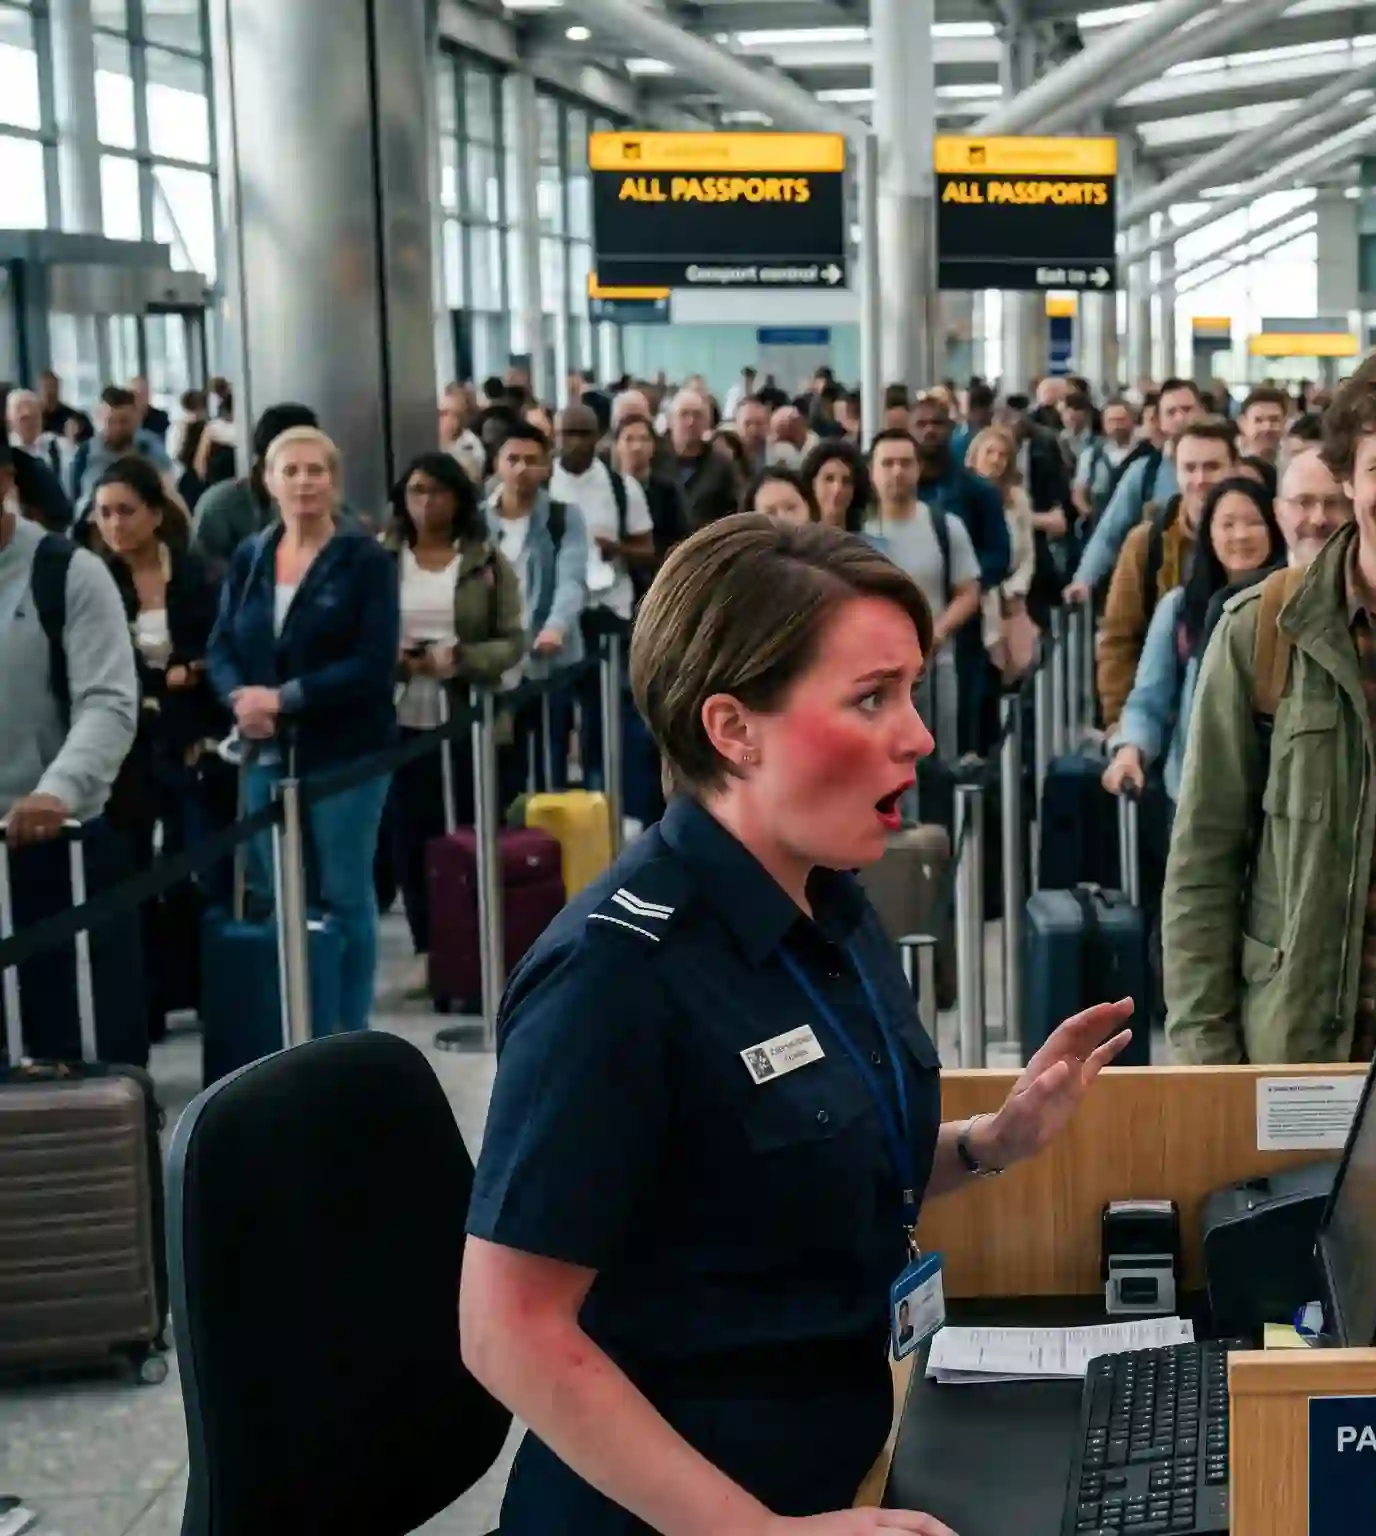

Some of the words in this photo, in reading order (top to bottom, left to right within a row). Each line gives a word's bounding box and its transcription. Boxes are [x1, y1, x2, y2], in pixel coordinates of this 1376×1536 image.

[618, 177, 667, 202] ALL
[671, 177, 811, 203] PASSPORTS
[942, 180, 984, 204] ALL
[987, 180, 1108, 205] PASSPORTS
